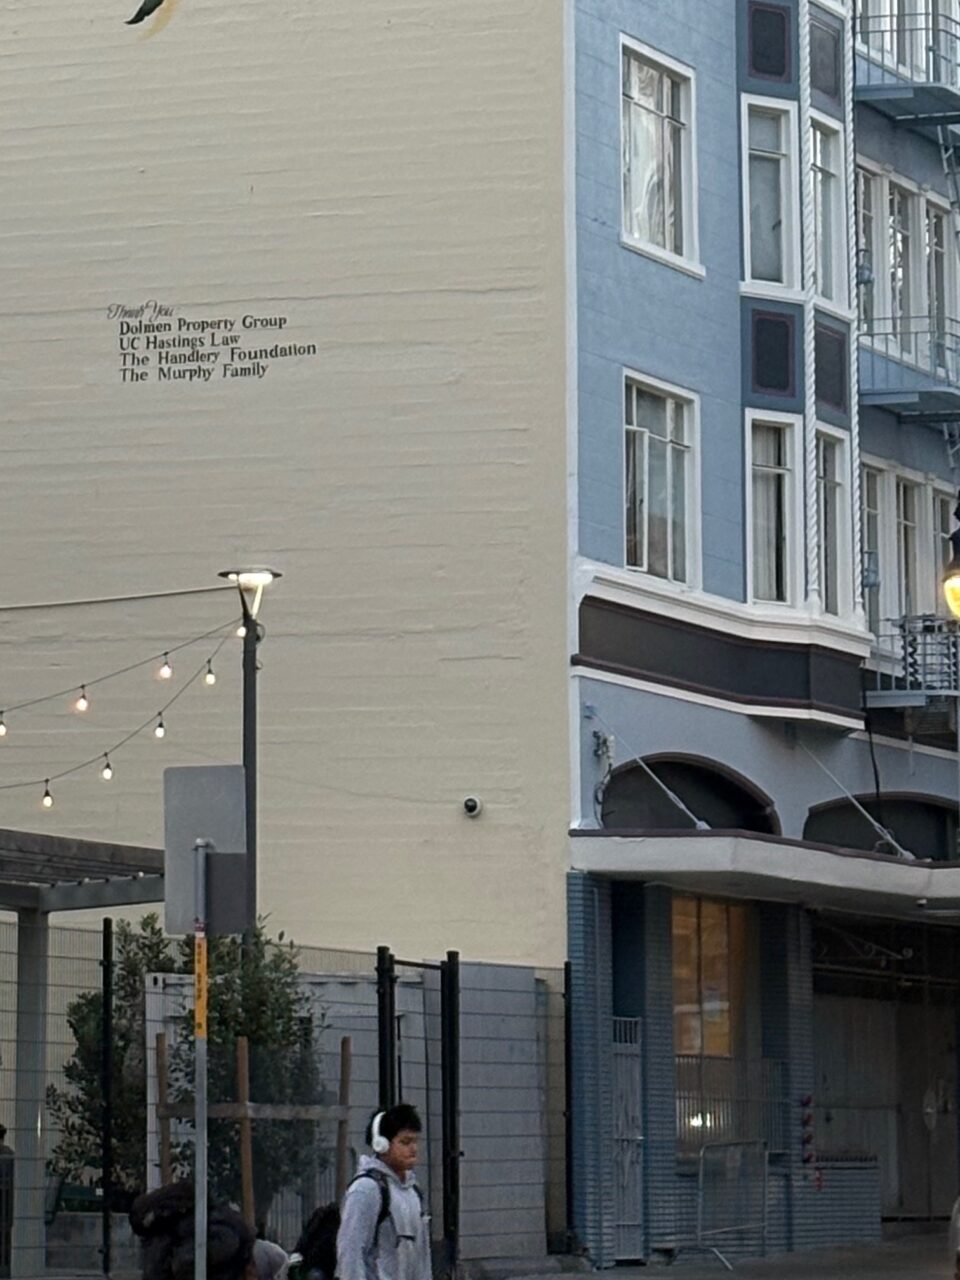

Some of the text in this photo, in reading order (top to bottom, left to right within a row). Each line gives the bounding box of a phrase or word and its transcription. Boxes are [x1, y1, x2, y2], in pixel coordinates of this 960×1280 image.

[107, 300, 174, 323] Thank You
[120, 315, 287, 335] Dolmen Property Group
[120, 332, 240, 351] UC Hastings Law
[120, 344, 316, 366] The Handlery Foundation
[120, 362, 269, 382] The Murphy Family
